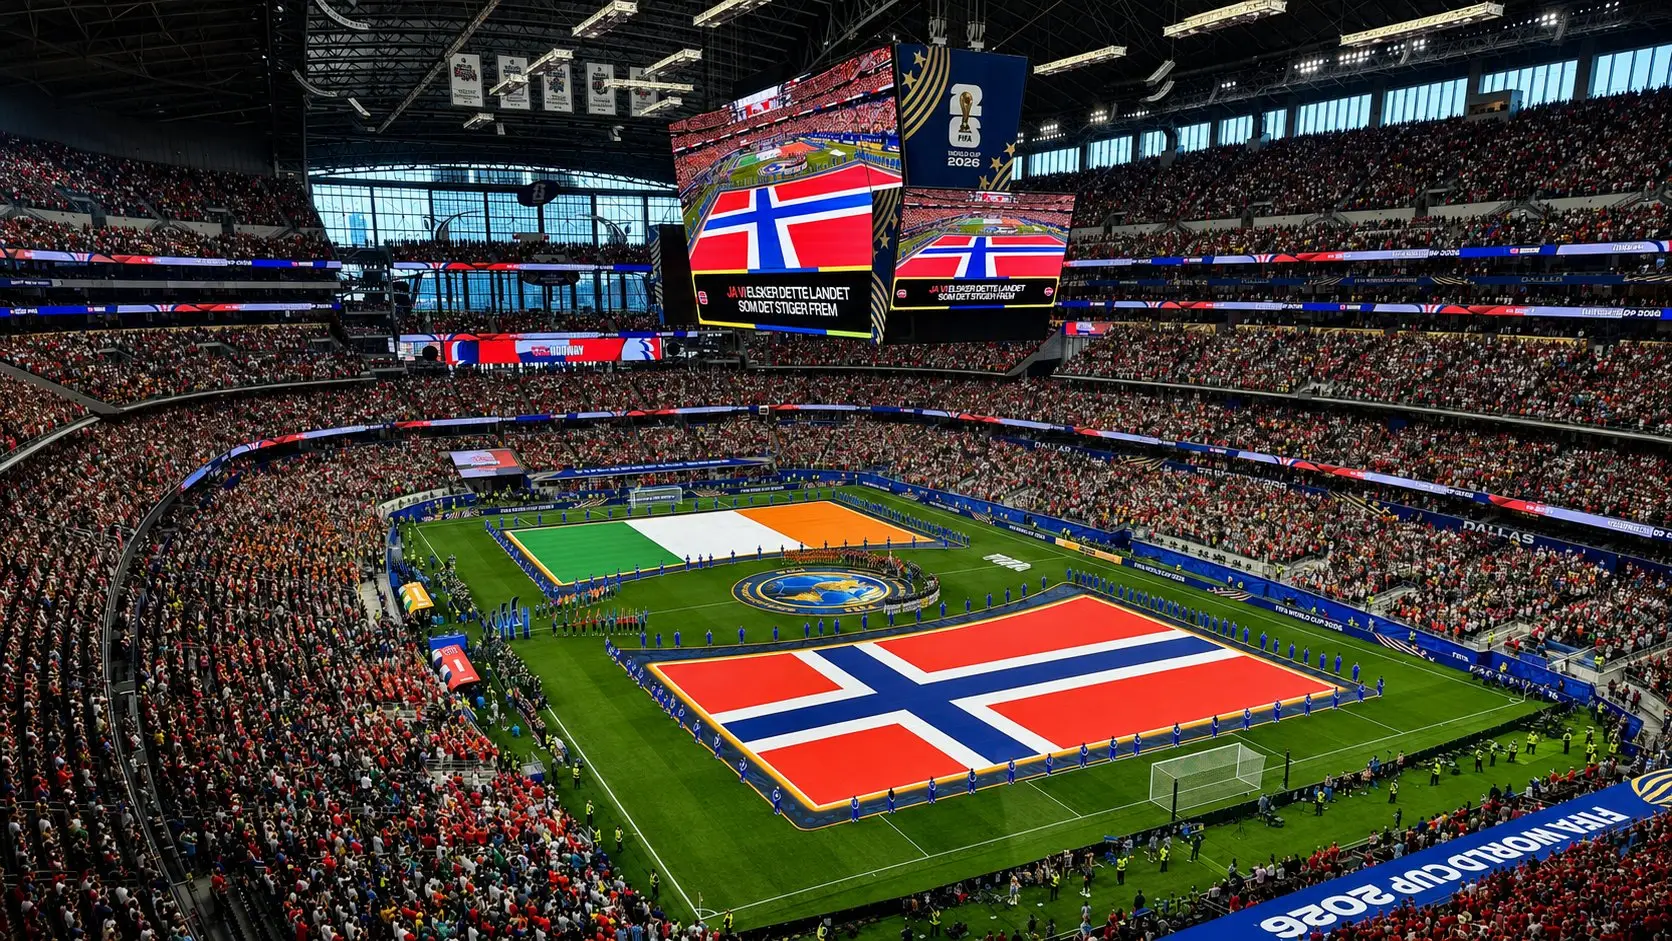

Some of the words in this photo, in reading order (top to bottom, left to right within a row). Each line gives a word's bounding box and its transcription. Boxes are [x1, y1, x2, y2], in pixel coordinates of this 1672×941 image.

[958, 134, 972, 142] FIFA
[947, 157, 980, 168] 2026
[727, 286, 738, 298] JA
[738, 286, 747, 298] VI
[747, 286, 779, 299] ELSKER
[779, 286, 809, 300] DETTE
[809, 286, 851, 301] LANDET
[929, 285, 939, 294] JA
[940, 284, 948, 293] VI
[738, 300, 758, 313] SOM
[758, 300, 774, 314] DET
[775, 301, 808, 316] STIGER
[808, 302, 838, 317] FREM
[1275, 605, 1288, 615] FIFA
[1289, 609, 1310, 621] WORLD
[1310, 615, 1324, 625] CUP
[1544, 806, 1630, 834] FIFA
[1448, 827, 1570, 871] WORLD
[1390, 864, 1462, 894] CUP
[1260, 884, 1395, 939] 2026
